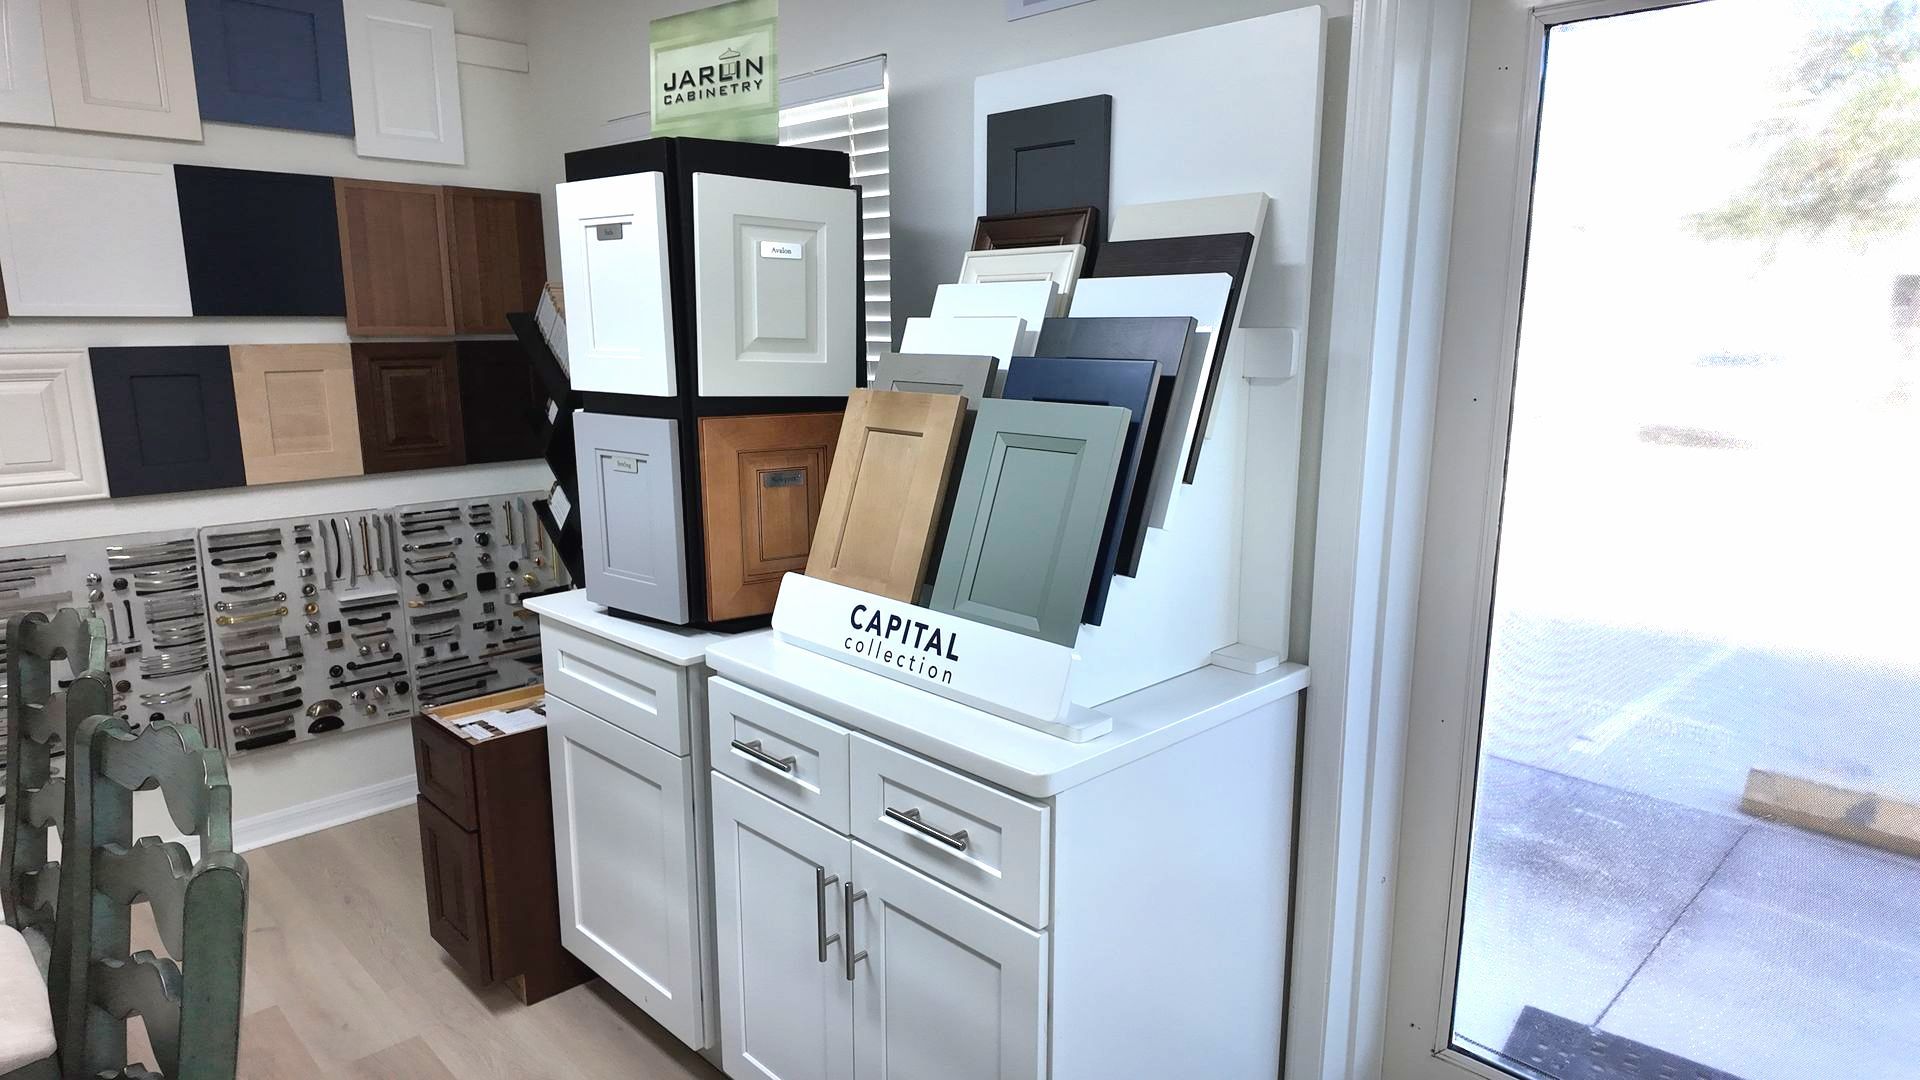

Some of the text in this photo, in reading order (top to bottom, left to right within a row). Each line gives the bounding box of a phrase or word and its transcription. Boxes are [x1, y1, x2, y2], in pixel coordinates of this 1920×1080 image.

[663, 56, 763, 92] JARLIN
[663, 79, 763, 105] CABINETRY
[771, 247, 792, 255] Avalon
[850, 604, 959, 662] CAPITAL
[844, 637, 952, 684] collection
